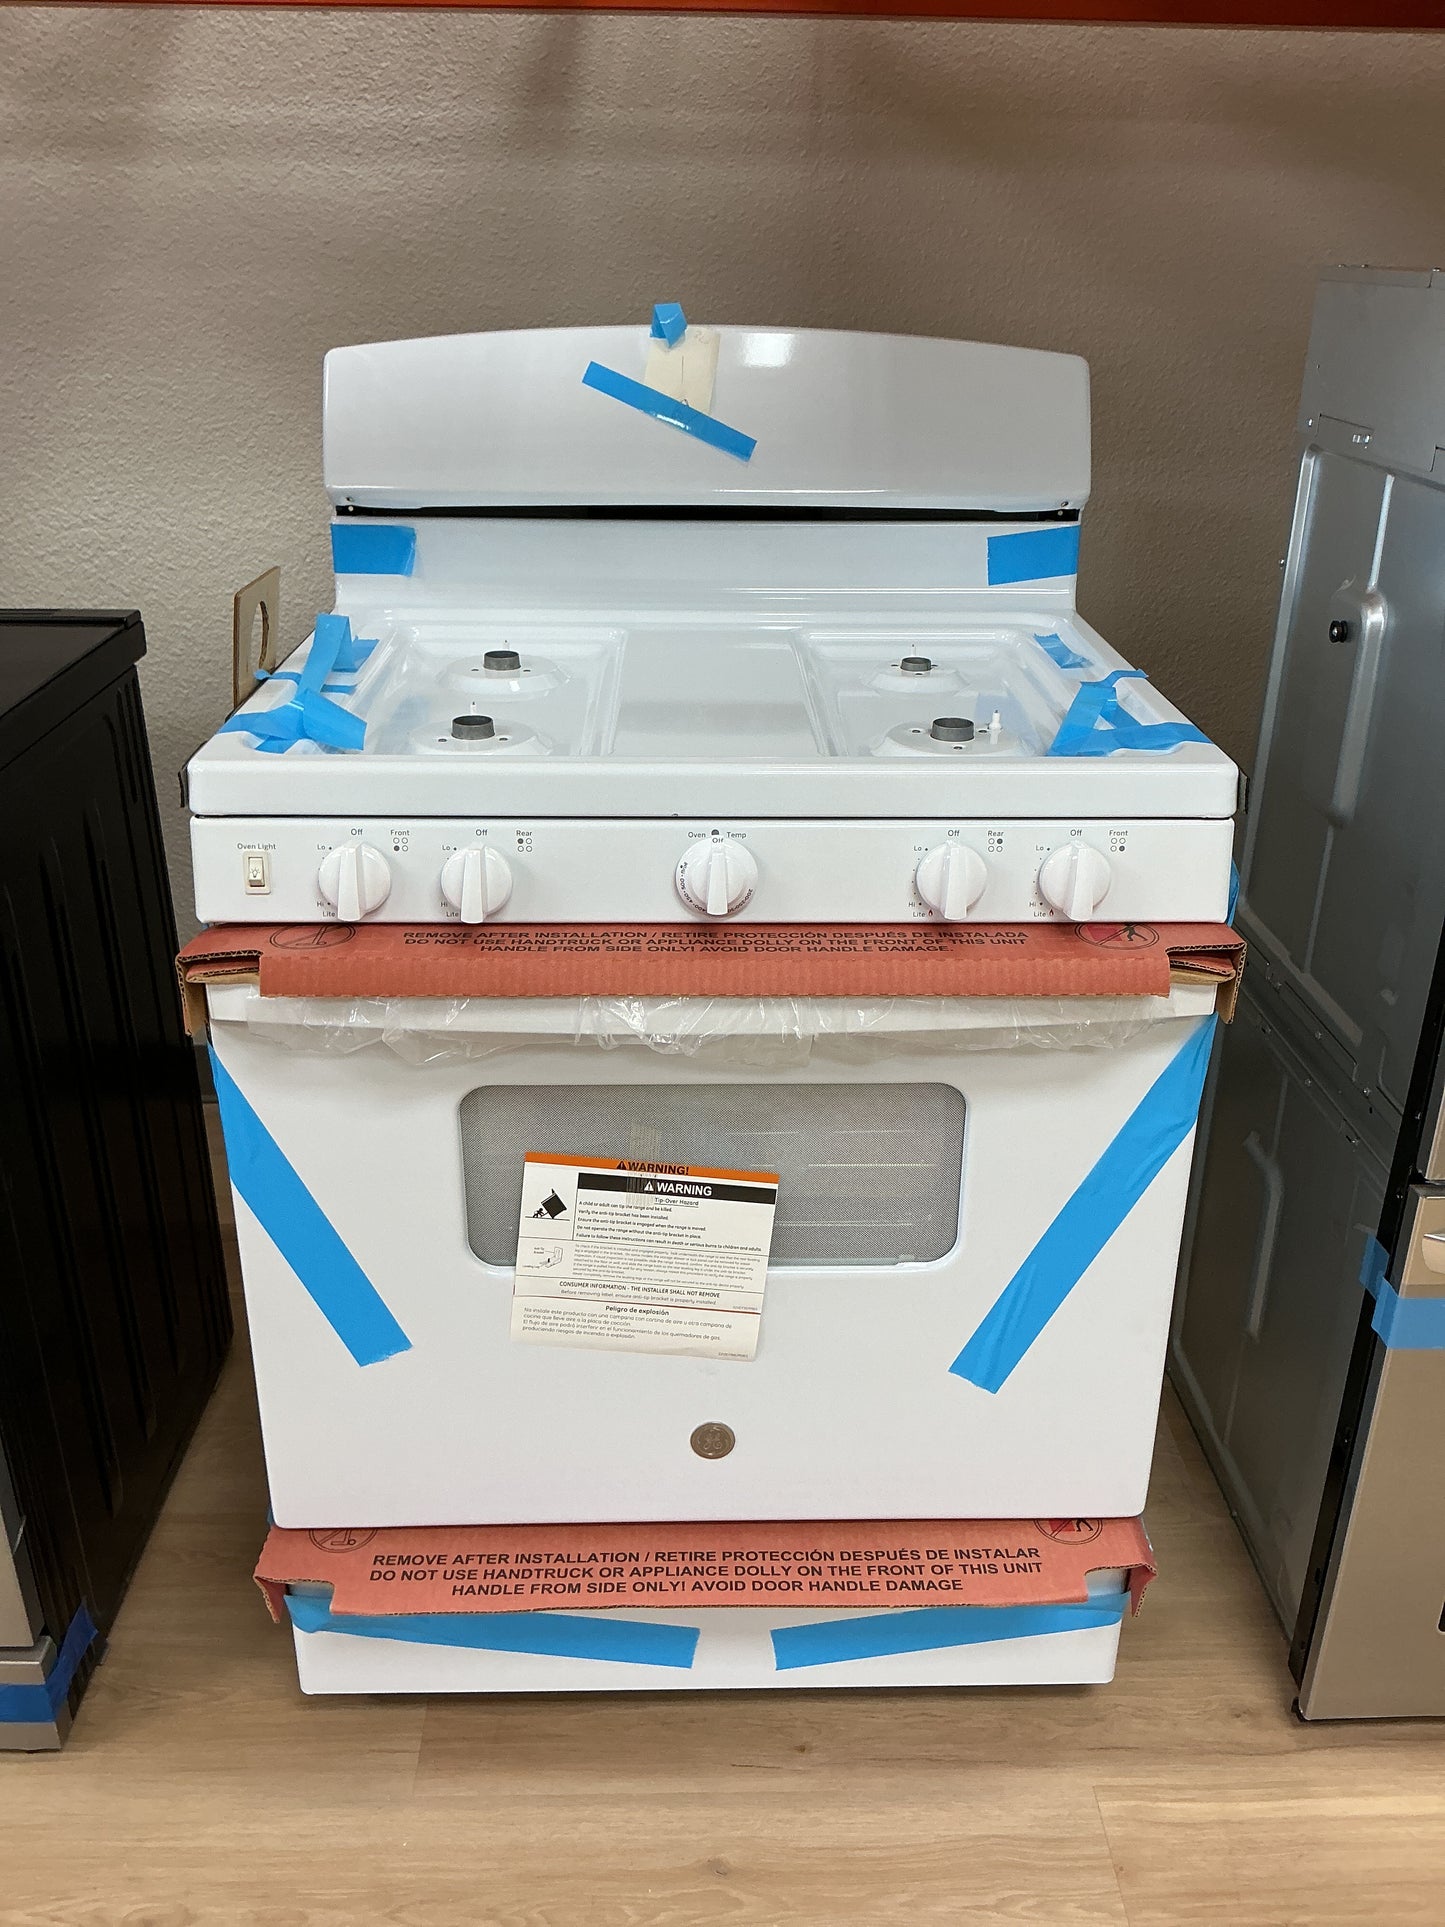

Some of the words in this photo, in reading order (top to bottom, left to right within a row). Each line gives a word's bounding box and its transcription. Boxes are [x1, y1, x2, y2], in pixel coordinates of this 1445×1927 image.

[258, 843, 276, 851] Light
[627, 1161, 689, 1175] WARNING!
[656, 1182, 713, 1196] WARNING
[590, 1283, 626, 1291] INFORMATION
[605, 1305, 628, 1313] Peligro
[373, 1554, 447, 1566] REMOVE
[452, 1554, 510, 1565] AFTER
[514, 1551, 640, 1564] INSTALLATION
[654, 1551, 716, 1562] RETIRE
[722, 1548, 835, 1562] PROTECCIÓN
[840, 1548, 921, 1562] DESPUÉS
[926, 1549, 950, 1560] DE
[953, 1547, 1040, 1560] INSTALAR
[370, 1570, 396, 1581] DO
[401, 1569, 438, 1581] NOT
[443, 1569, 477, 1580] USE
[483, 1567, 594, 1580] HANDTRUCK
[598, 1567, 624, 1578] OR
[628, 1565, 730, 1577] APPLIANCE
[734, 1565, 793, 1577] DOLLY
[797, 1565, 823, 1577] ON
[827, 1565, 862, 1576] THE
[867, 1564, 926, 1576] FRONT
[930, 1564, 954, 1575] OF
[958, 1563, 998, 1575] THIS
[1003, 1562, 1042, 1574] UNIT
[452, 1584, 524, 1596] HANDLE
[530, 1583, 581, 1595] FROM
[586, 1581, 627, 1593] SIDE
[632, 1581, 686, 1593] ONLY!
[691, 1580, 746, 1592] AVOID
[752, 1580, 804, 1592] DOOR
[808, 1580, 881, 1591] HANDLE
[886, 1579, 963, 1591] DAMAGE
